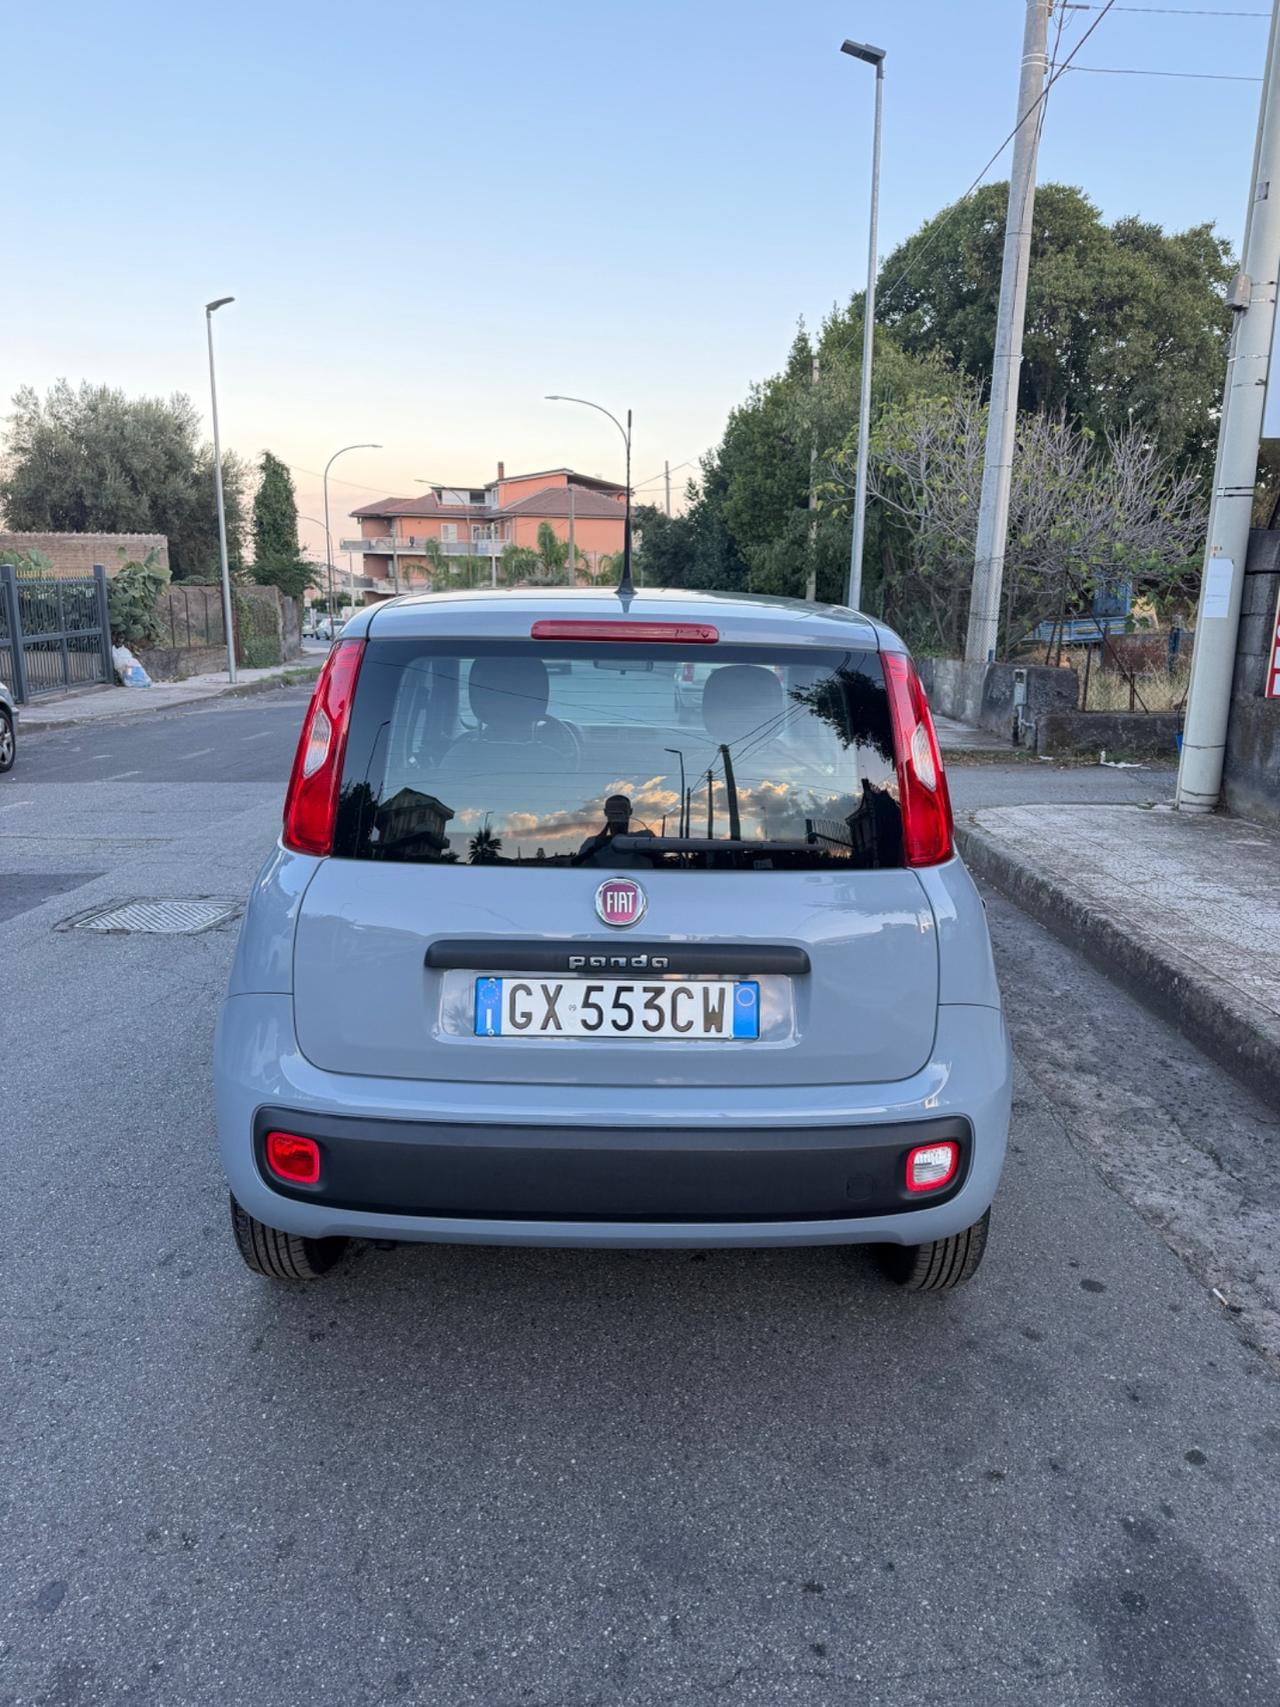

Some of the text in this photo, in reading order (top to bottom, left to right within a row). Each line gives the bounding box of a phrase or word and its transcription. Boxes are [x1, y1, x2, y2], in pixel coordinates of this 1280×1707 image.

[606, 891, 635, 913] FIAT
[568, 954, 669, 970] panda
[509, 983, 726, 1033] GX 553CW
